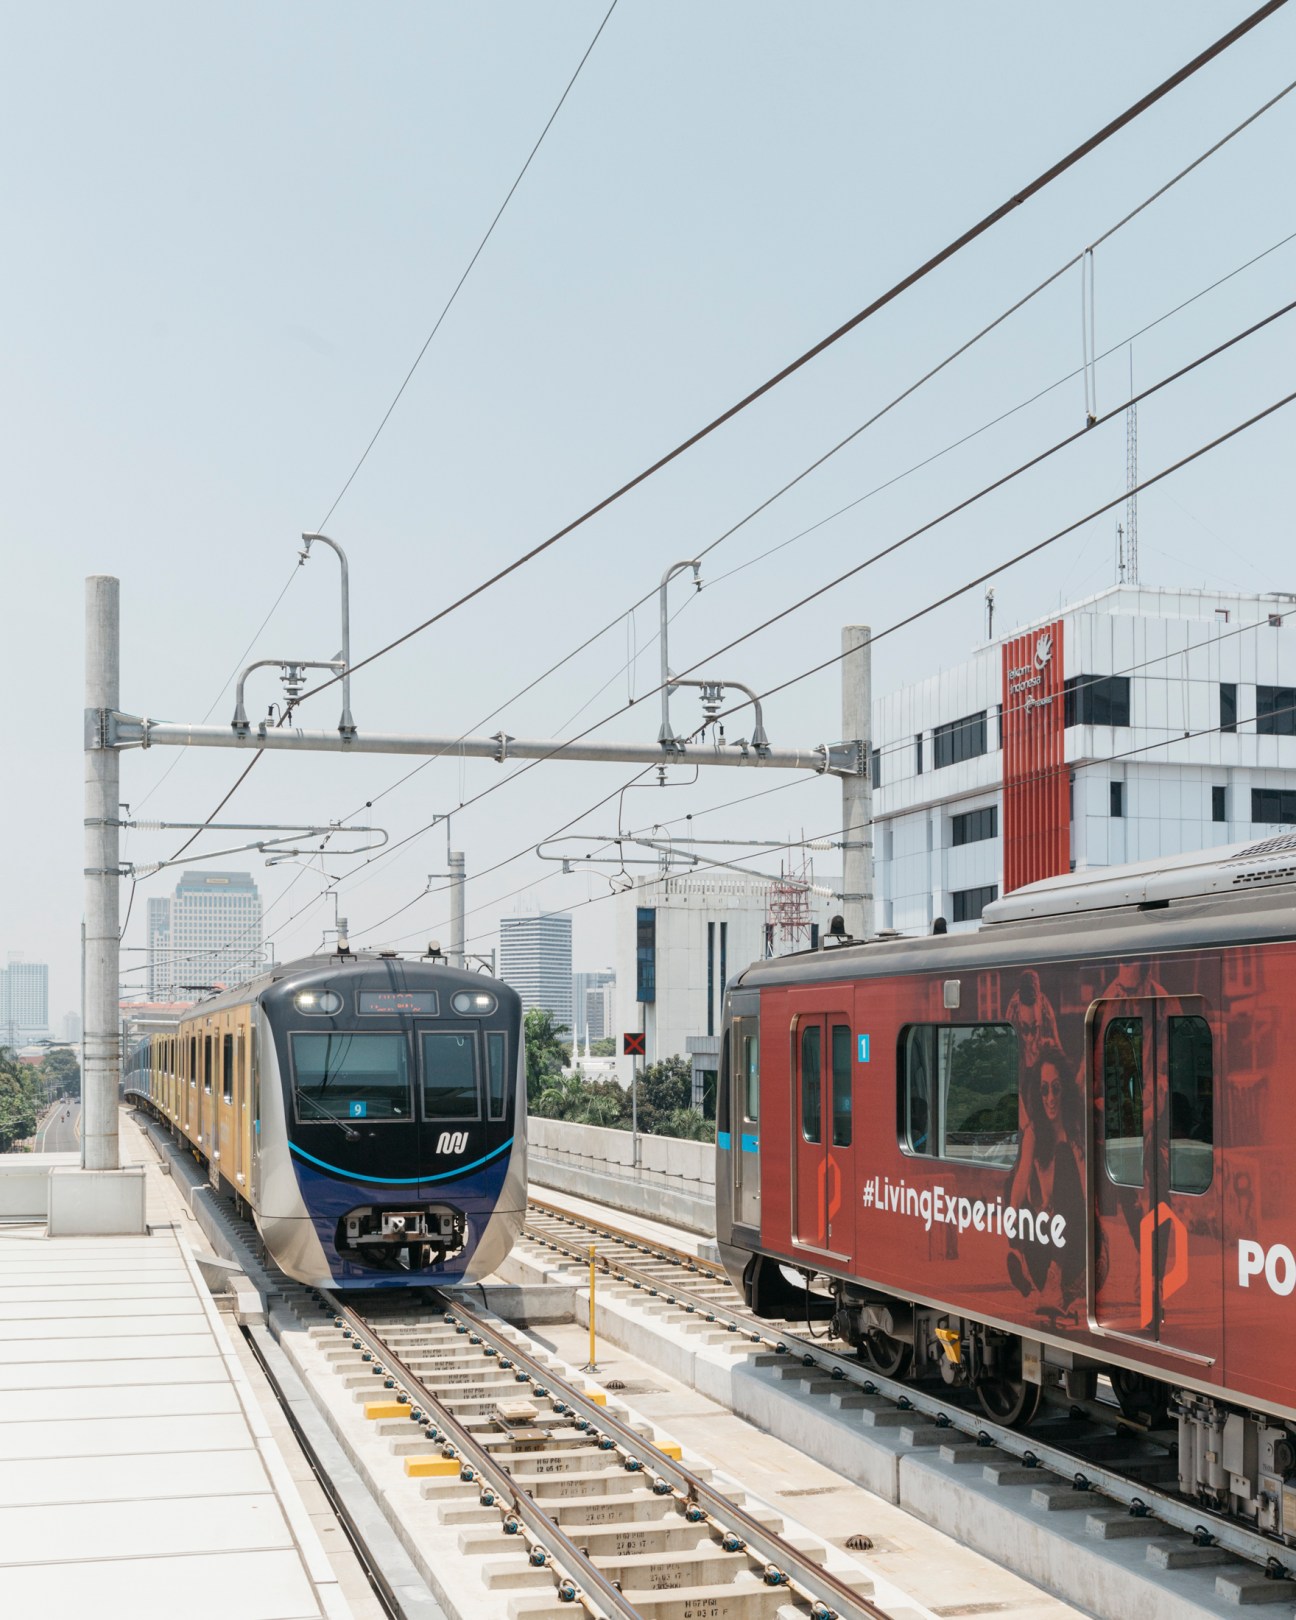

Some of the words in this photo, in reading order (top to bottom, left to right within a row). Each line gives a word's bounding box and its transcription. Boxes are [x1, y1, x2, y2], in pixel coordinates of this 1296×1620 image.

[860, 1038, 866, 1059] 1
[354, 1104, 362, 1116] 9
[862, 1176, 1067, 1249] #LivingExperience
[1238, 1238, 1296, 1297] PO
